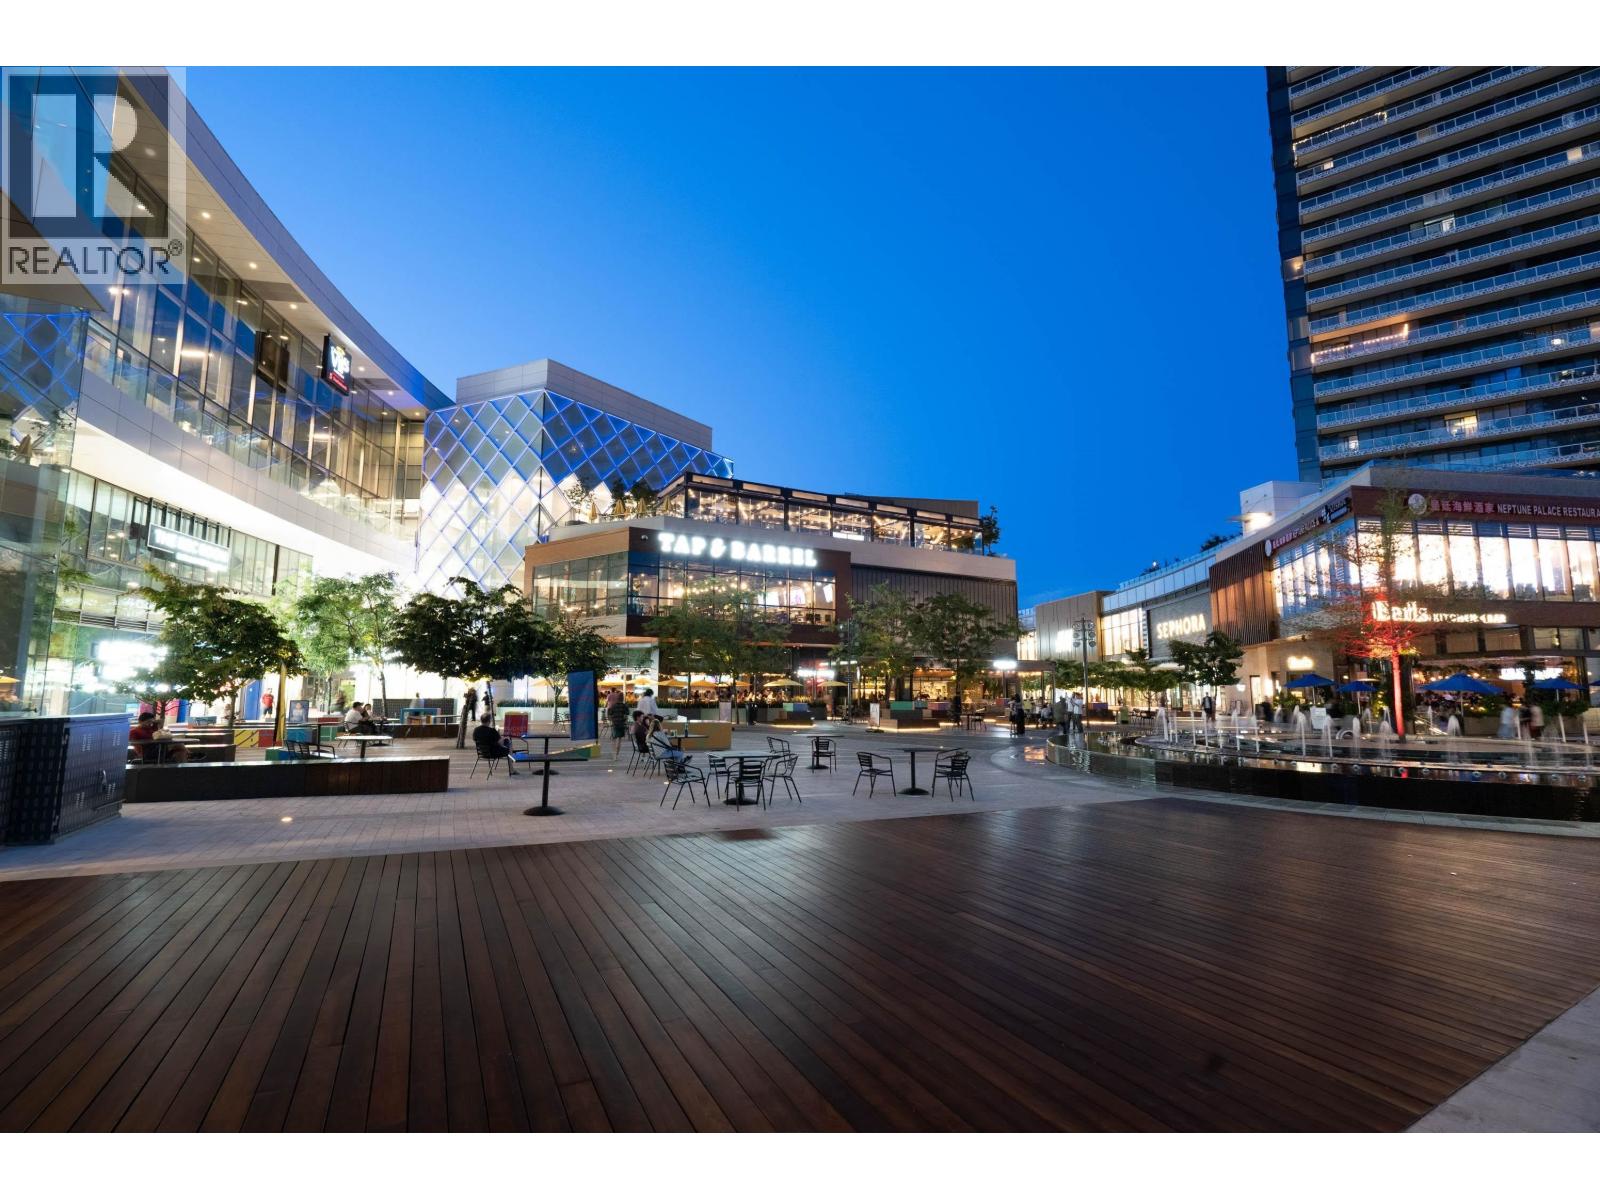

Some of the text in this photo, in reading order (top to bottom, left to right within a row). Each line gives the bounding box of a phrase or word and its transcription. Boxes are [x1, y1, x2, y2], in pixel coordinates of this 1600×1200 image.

[1497, 504, 1532, 515] NEPTUNE
[1533, 506, 1561, 516] PALACE
[658, 532, 817, 567] TAP & BARREL
[1156, 613, 1206, 639] SEPHORA
